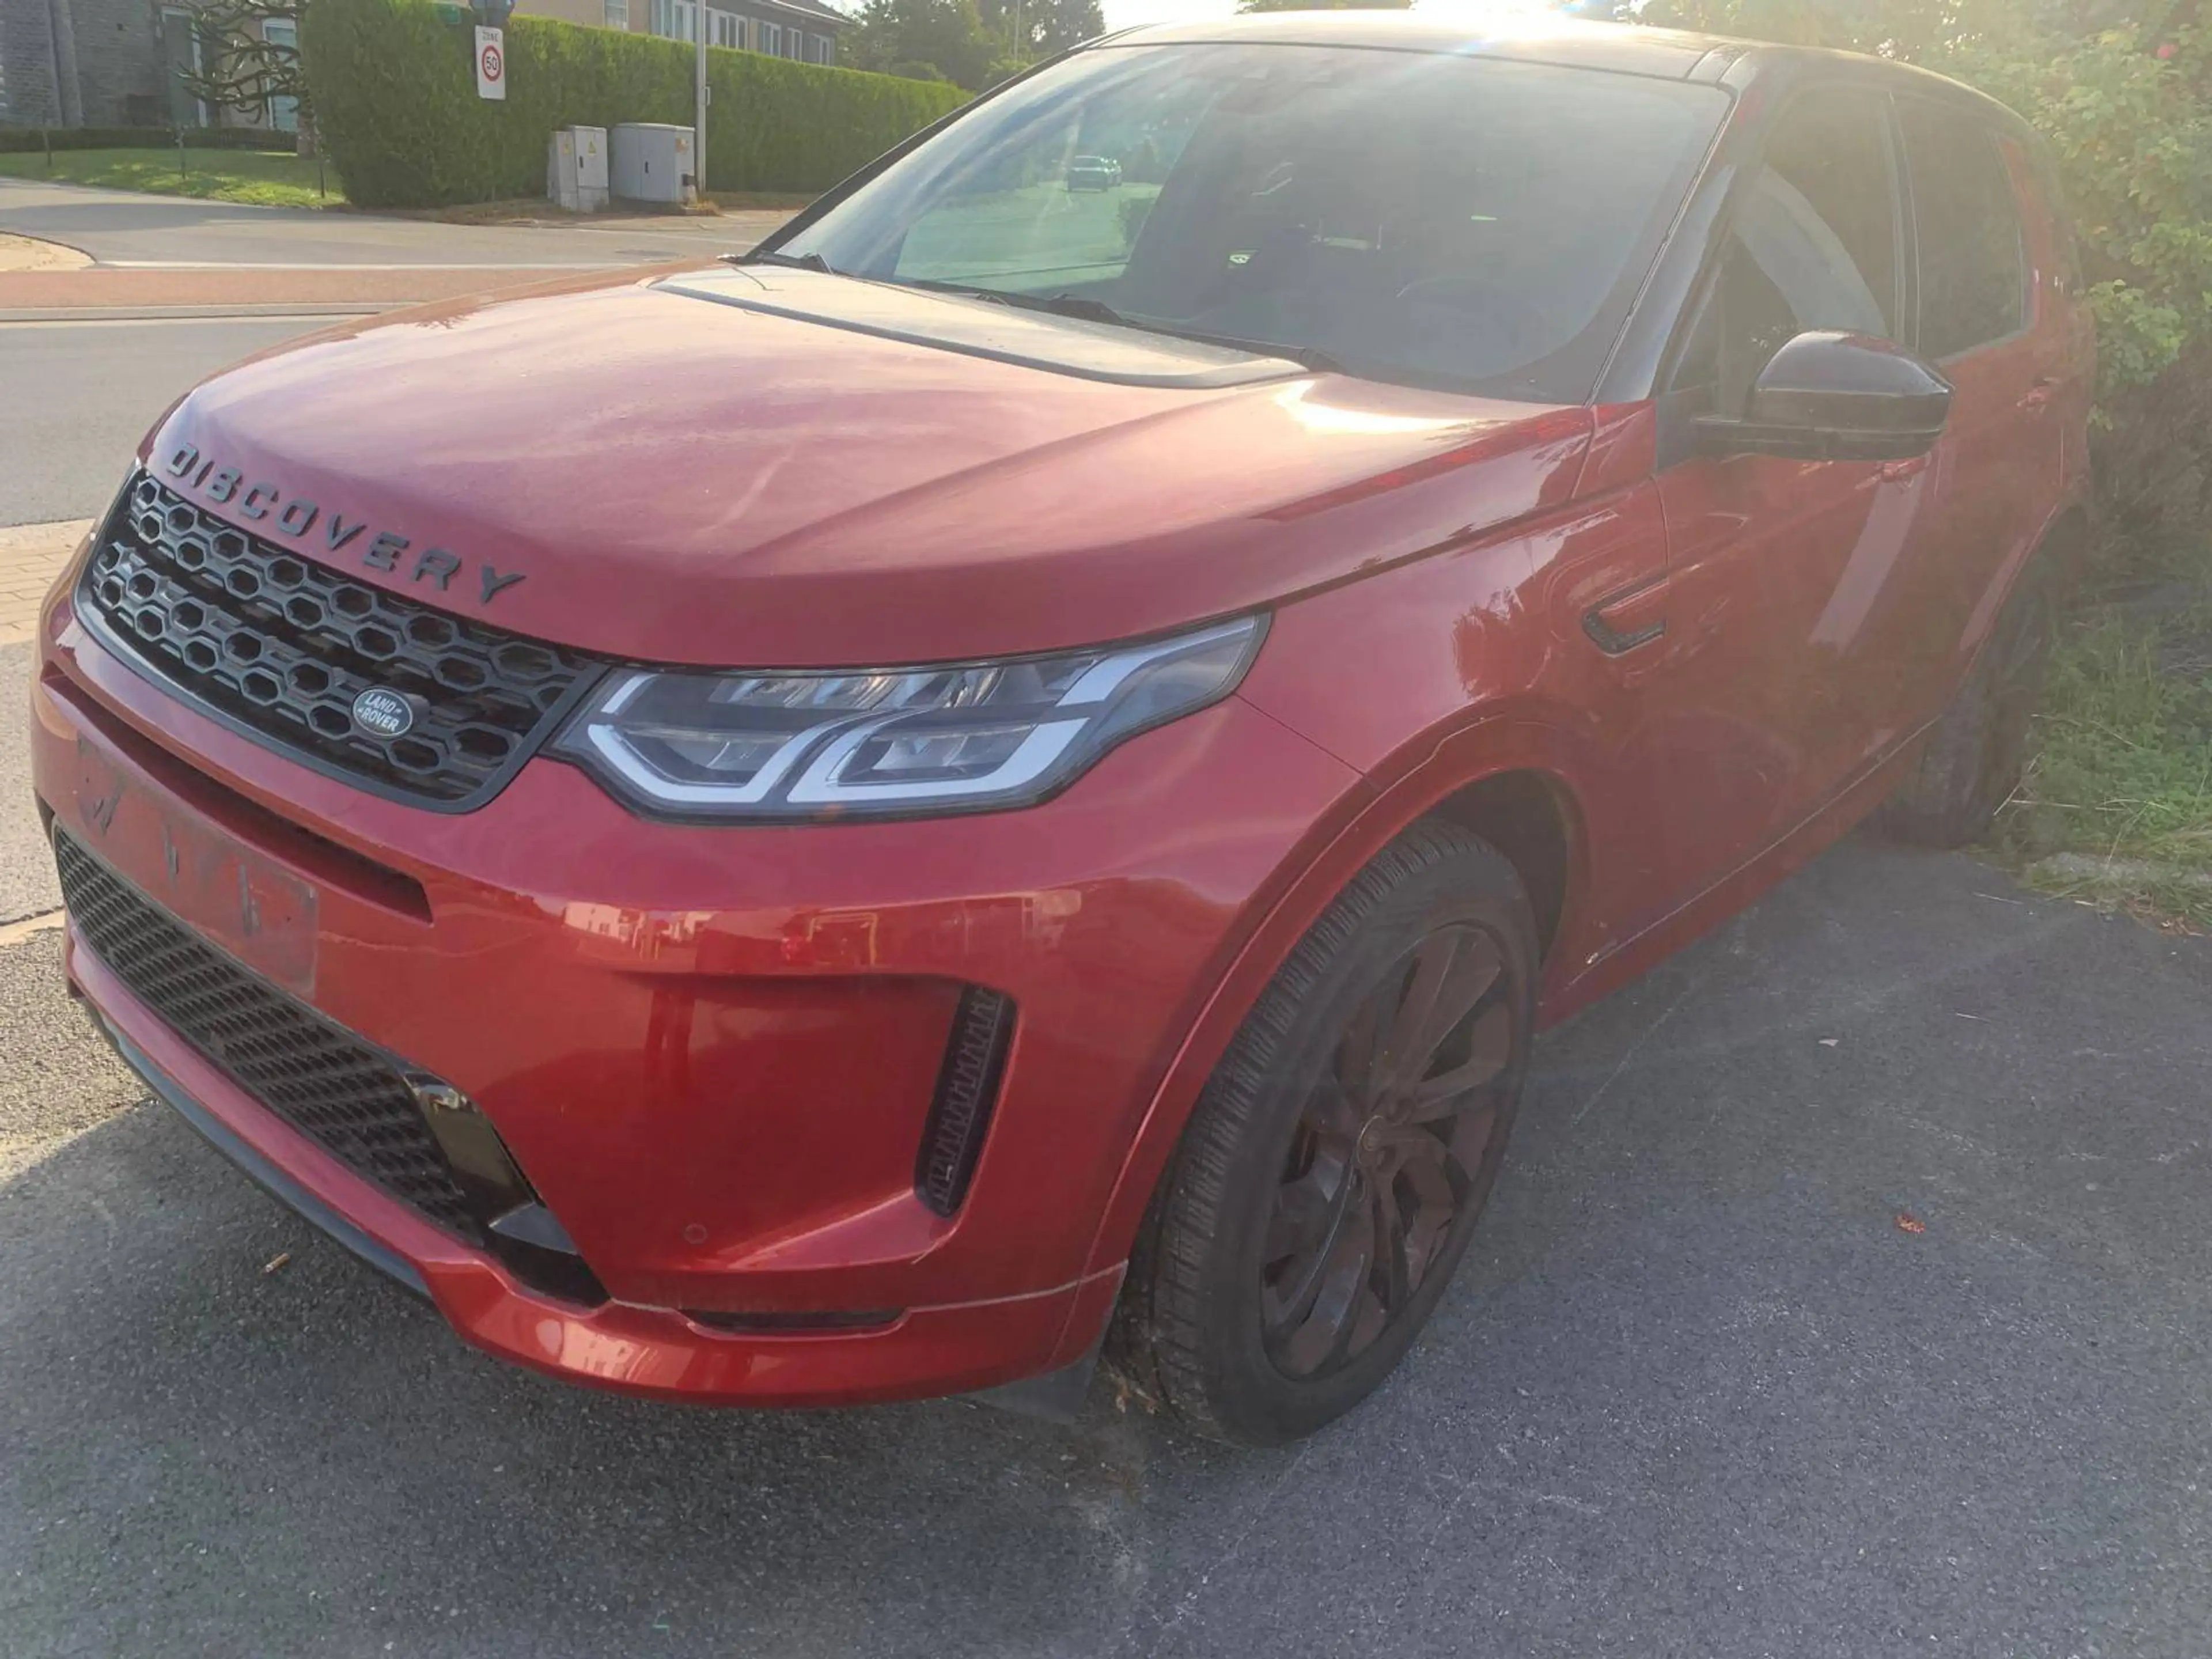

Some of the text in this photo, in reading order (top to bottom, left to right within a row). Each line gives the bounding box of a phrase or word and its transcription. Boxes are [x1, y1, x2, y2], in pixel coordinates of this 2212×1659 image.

[486, 55, 498, 70] 50
[166, 442, 527, 604] DISCOVERY
[365, 692, 396, 714] LAND
[361, 707, 399, 732] ROVER
